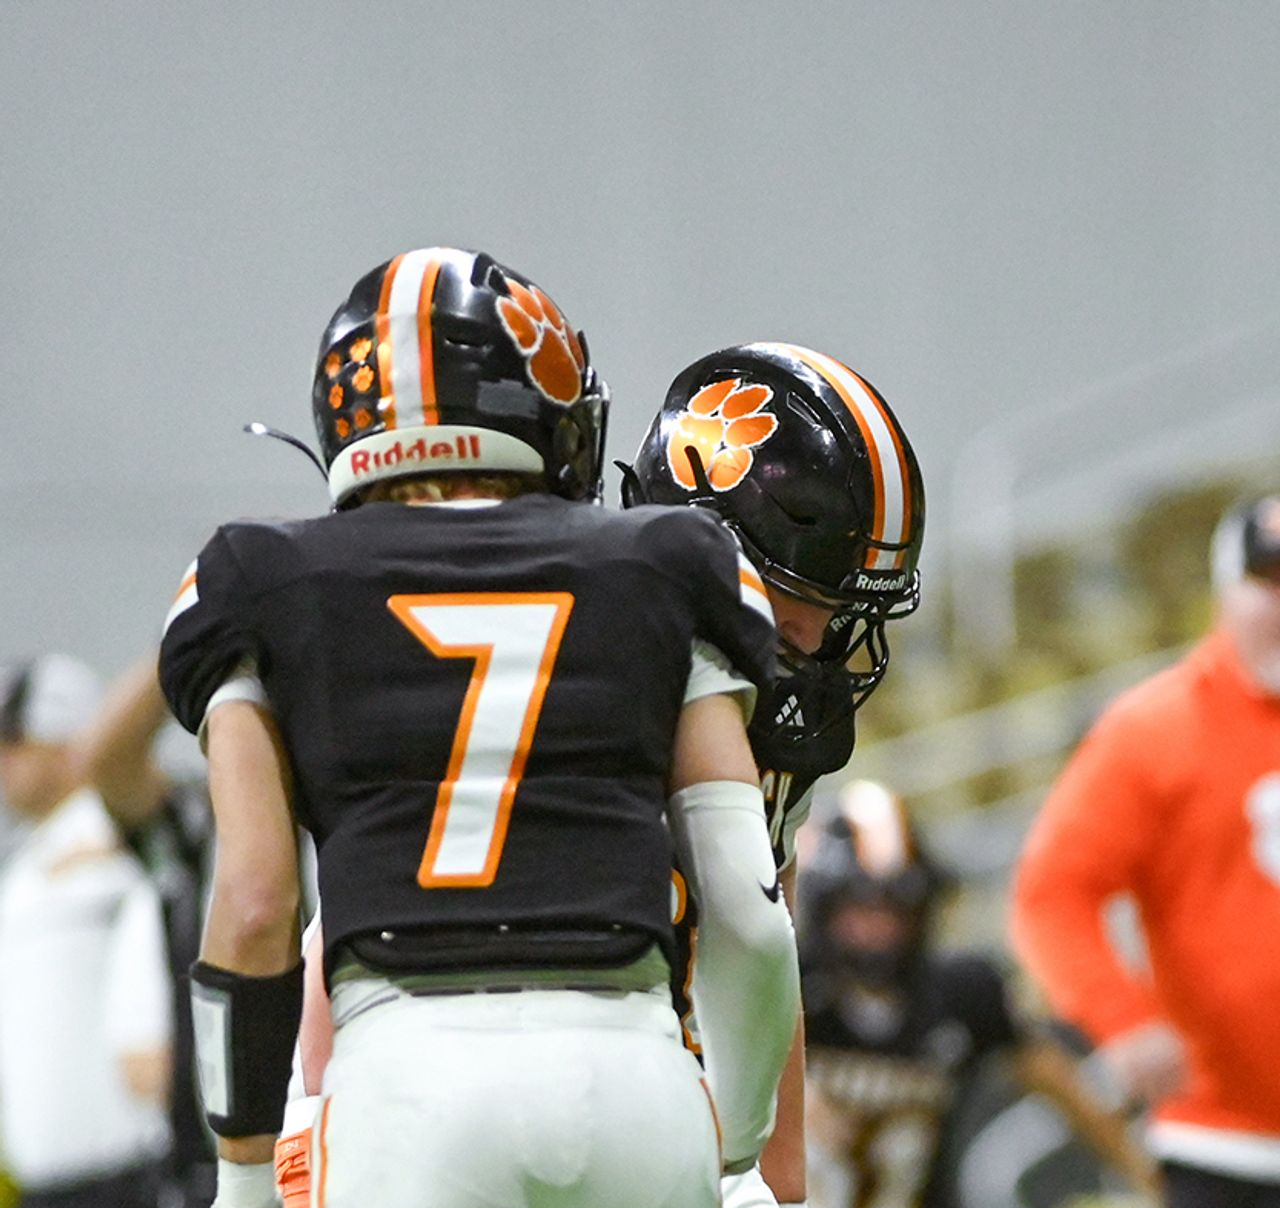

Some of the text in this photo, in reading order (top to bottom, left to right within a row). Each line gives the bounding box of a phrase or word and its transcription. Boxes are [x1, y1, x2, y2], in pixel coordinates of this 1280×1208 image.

[350, 434, 481, 476] Riddell
[856, 573, 906, 591] Riddell
[386, 591, 575, 888] 7
